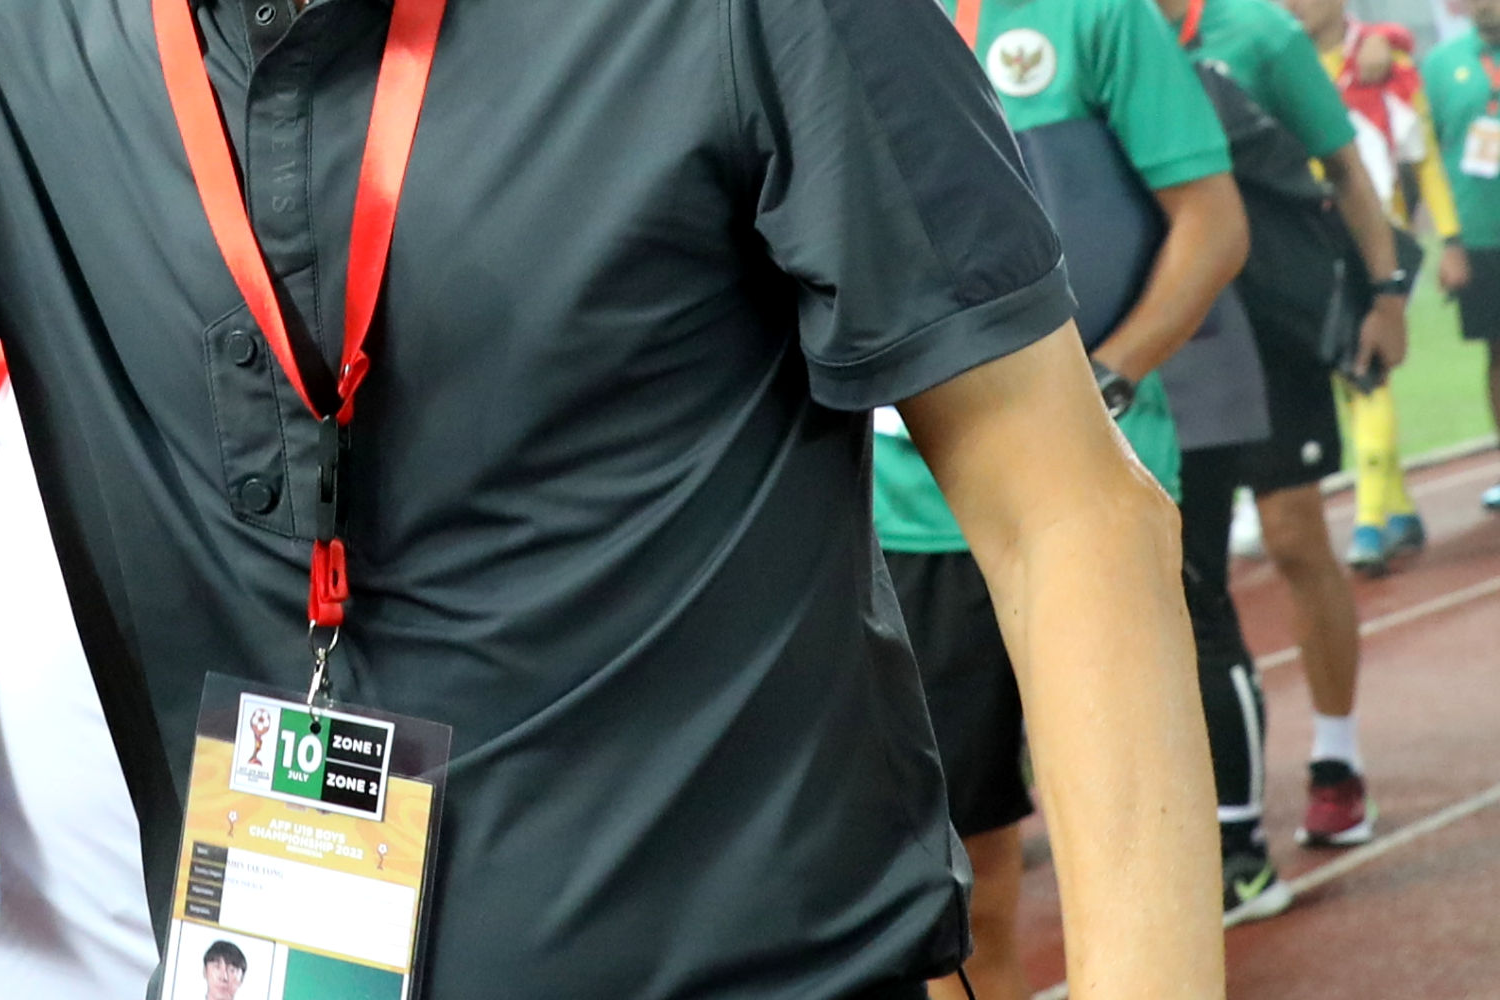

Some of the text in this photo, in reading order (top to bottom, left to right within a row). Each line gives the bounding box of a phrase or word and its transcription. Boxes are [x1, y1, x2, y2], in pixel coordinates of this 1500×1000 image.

[281, 730, 323, 774] 10
[333, 735, 382, 757] ZONE 1
[288, 771, 310, 783] JULY
[327, 773, 378, 796] ZONE 2
[248, 826, 335, 853] CHAMPIONSHIP
